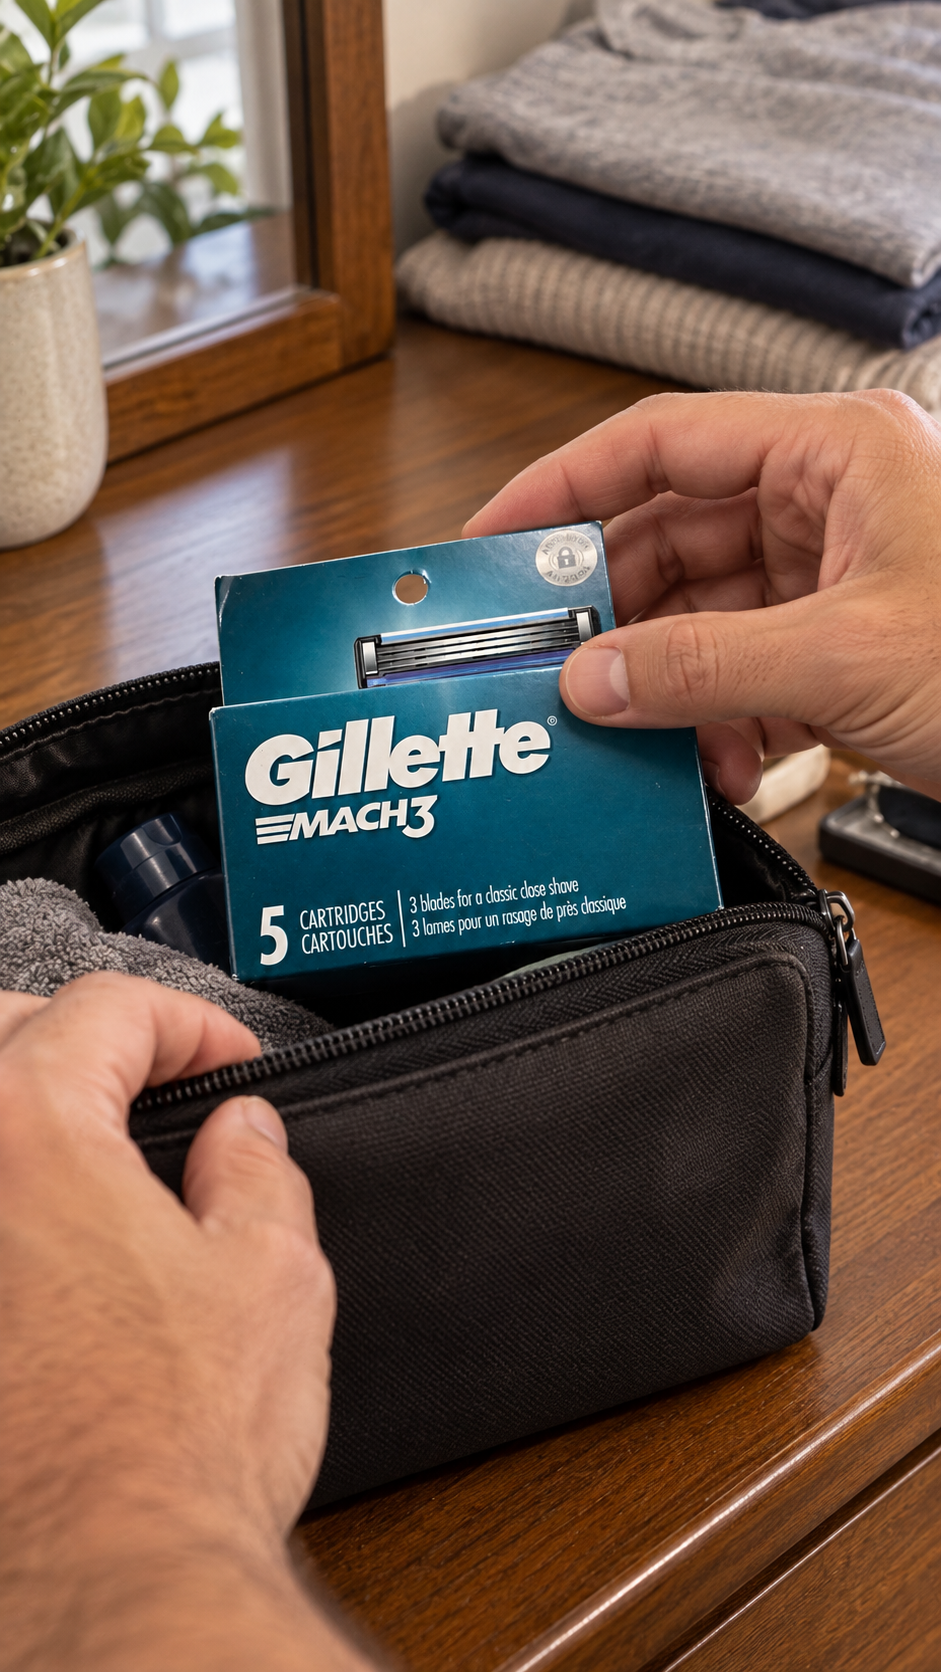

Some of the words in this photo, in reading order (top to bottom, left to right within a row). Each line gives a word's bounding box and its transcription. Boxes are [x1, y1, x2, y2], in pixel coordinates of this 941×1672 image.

[288, 794, 438, 839] MACH3
[300, 900, 386, 930] CARTRIDGES
[409, 896, 418, 914] 3
[420, 891, 455, 913] blades
[457, 888, 473, 908] for
[475, 892, 483, 905] a
[485, 884, 518, 903] classic
[520, 880, 546, 900] close
[548, 876, 579, 896] shave
[260, 905, 288, 966] 5
[411, 919, 420, 938] 3
[422, 917, 455, 936] lames
[458, 915, 482, 936] pour
[485, 912, 499, 928] un
[502, 909, 537, 927] rasage
[540, 902, 553, 921] de
[556, 905, 578, 922] près
[581, 895, 627, 916] classique
[301, 923, 394, 955] CARTOUCHES
